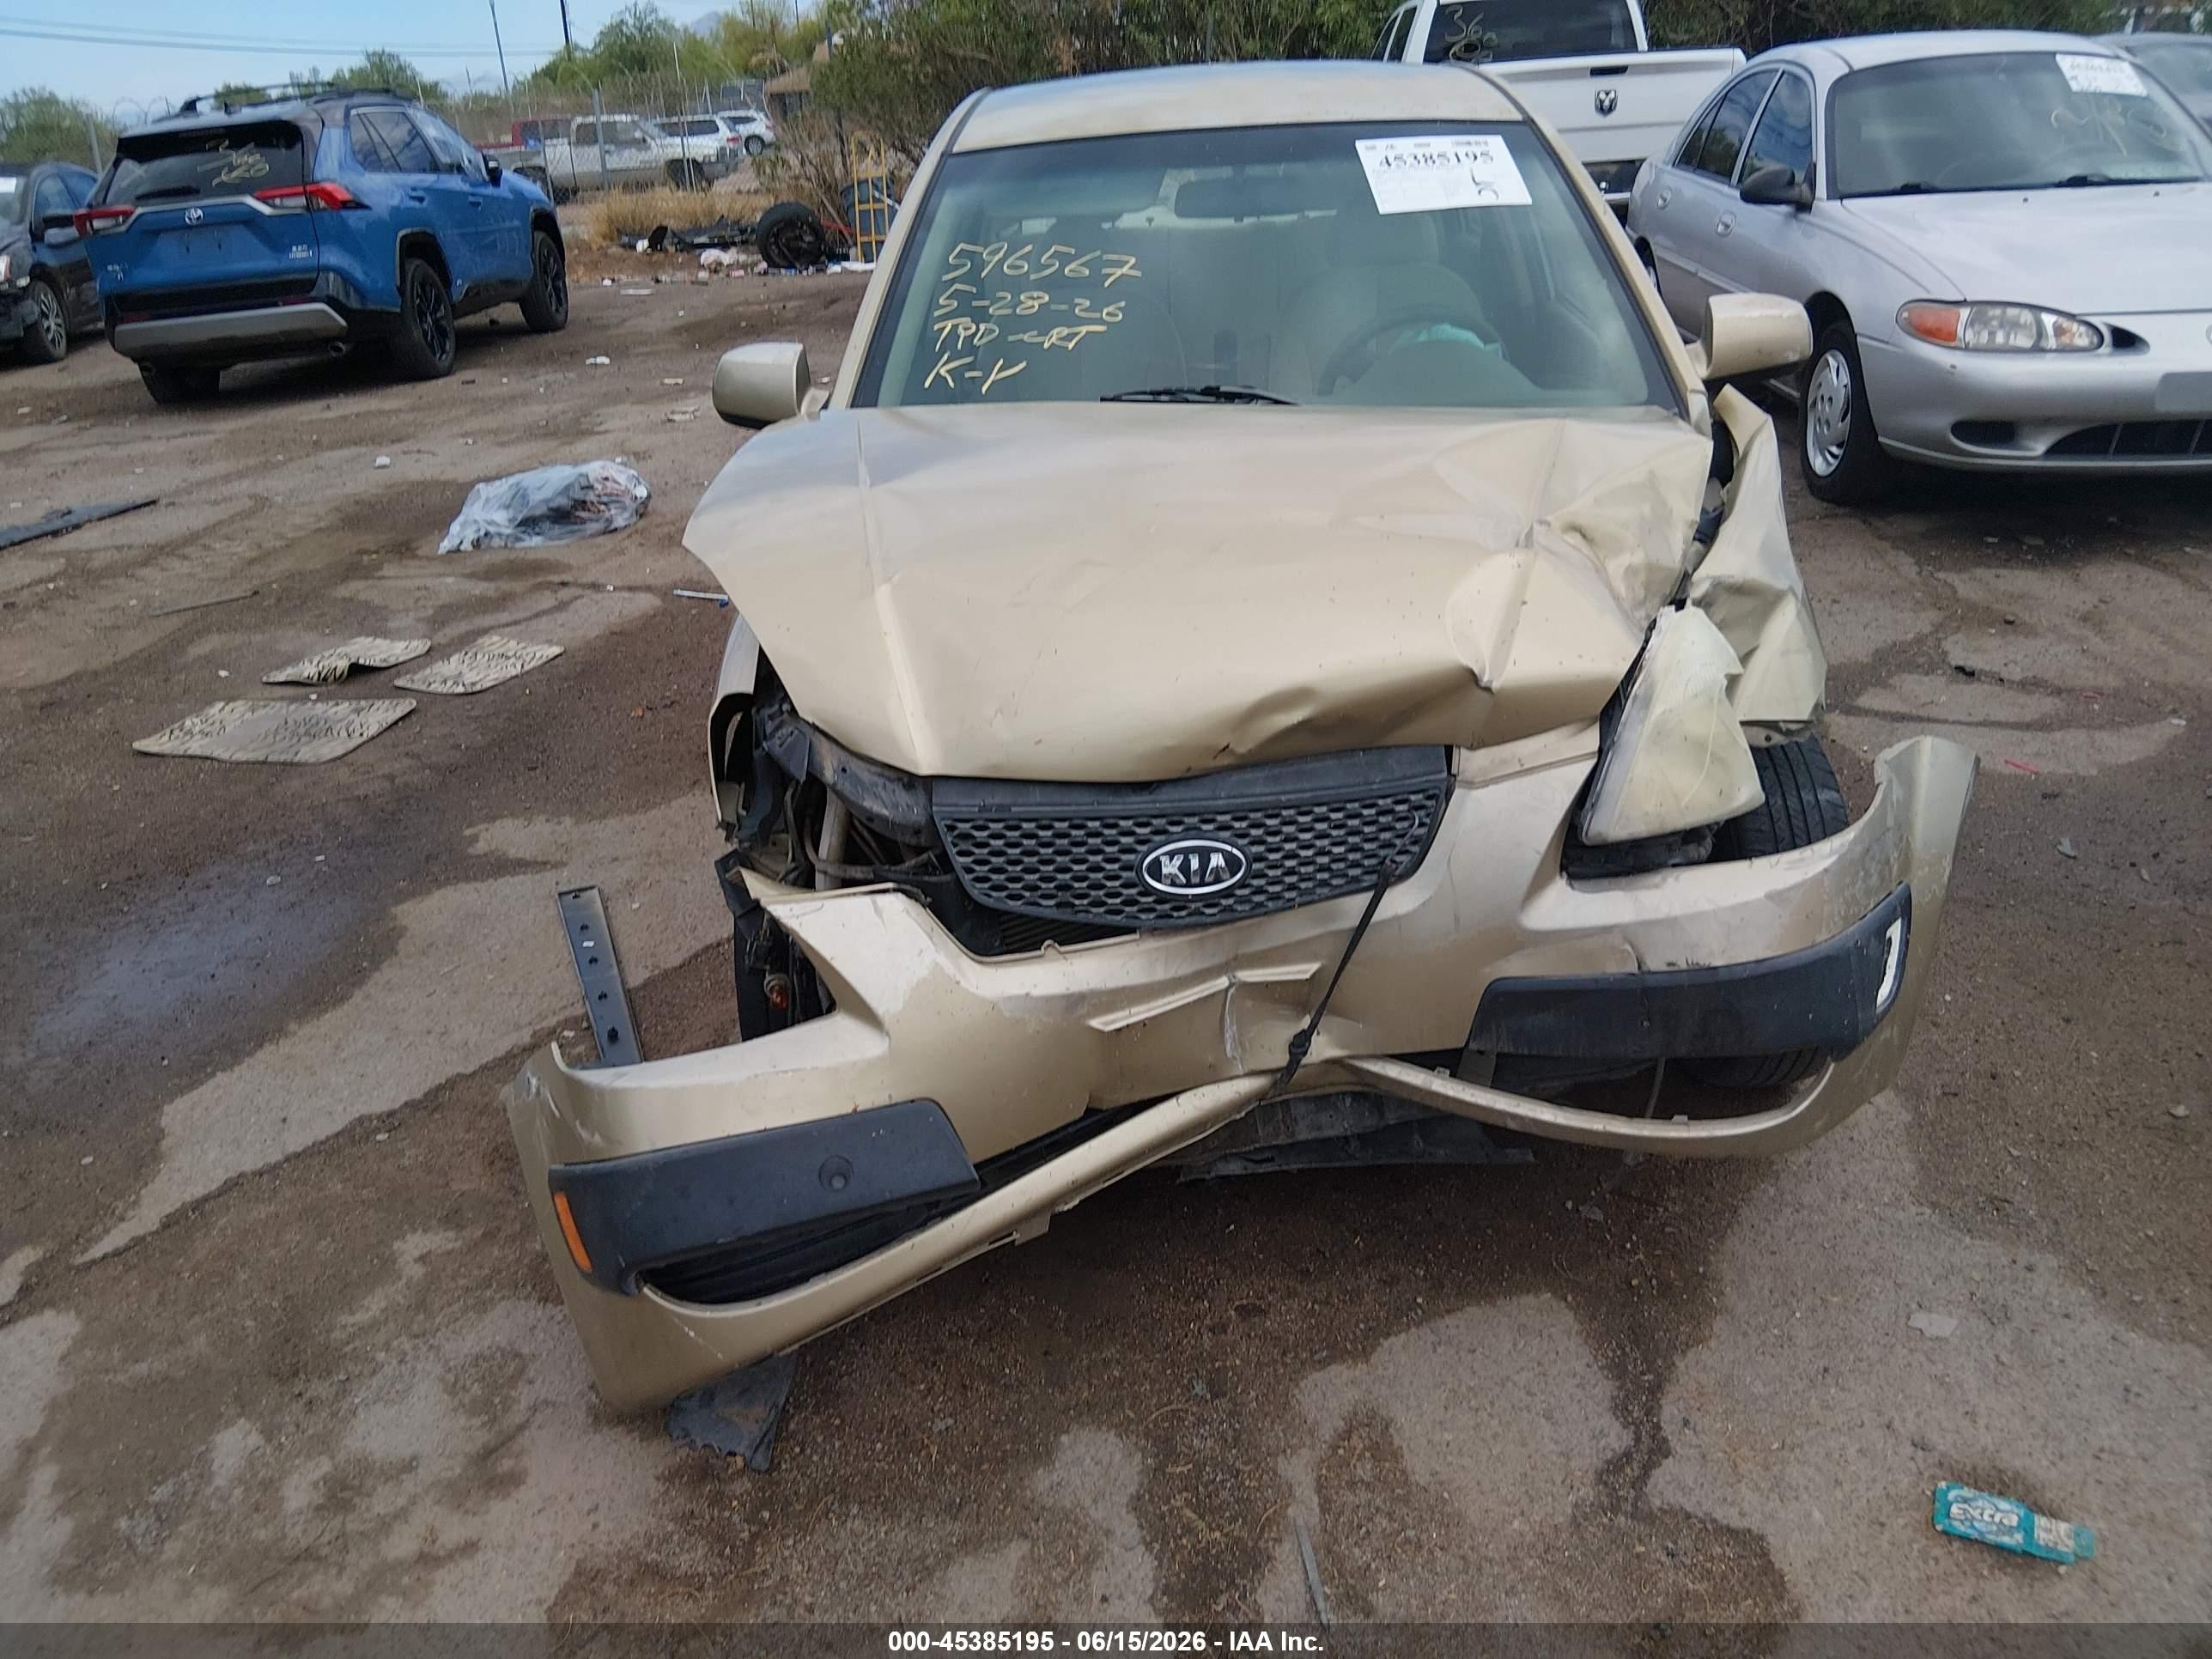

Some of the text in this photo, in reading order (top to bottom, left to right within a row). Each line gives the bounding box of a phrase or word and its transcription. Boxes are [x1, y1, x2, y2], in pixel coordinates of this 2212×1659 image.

[942, 241, 1142, 289] 596567
[933, 283, 1126, 322] 5-28-26
[1160, 852, 1231, 885] KIA
